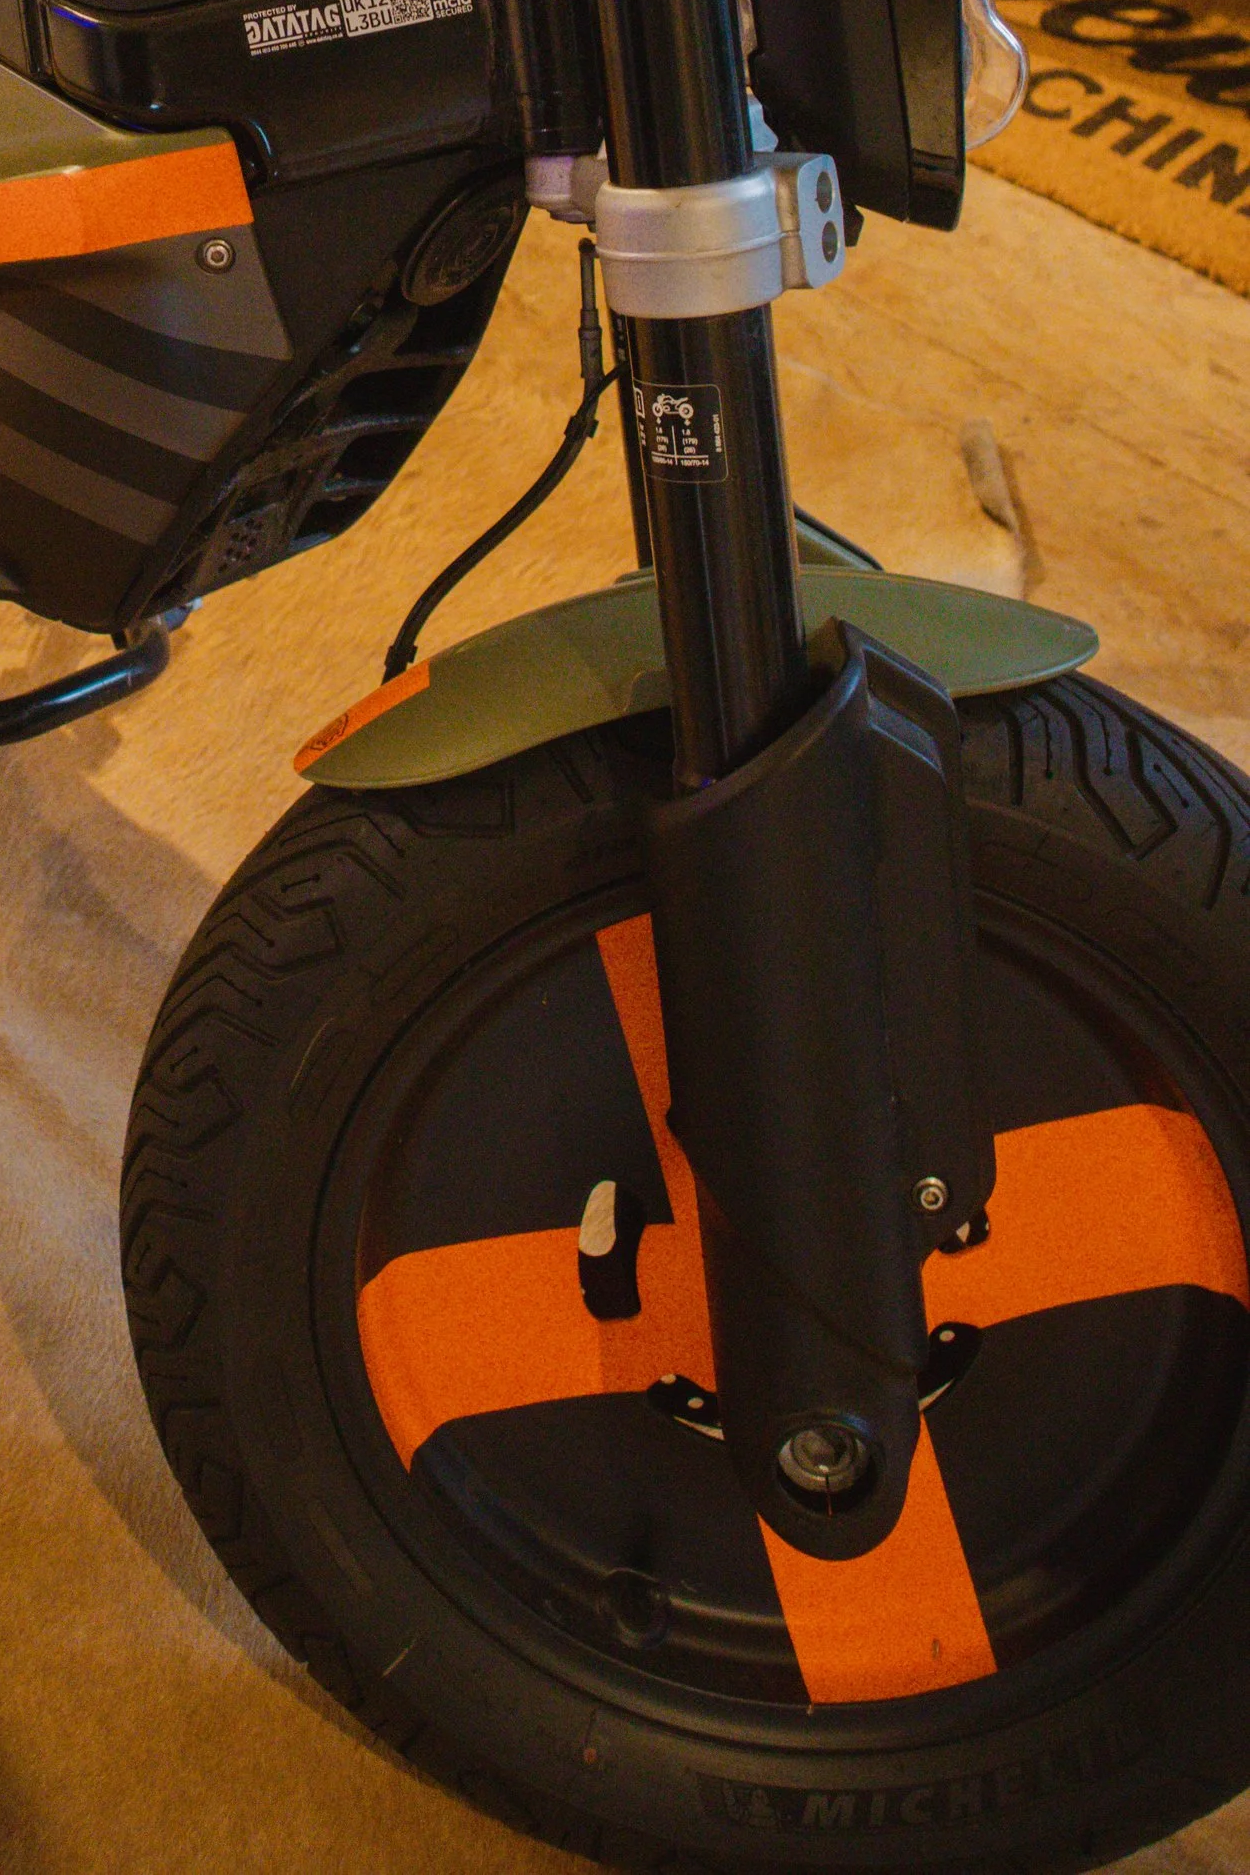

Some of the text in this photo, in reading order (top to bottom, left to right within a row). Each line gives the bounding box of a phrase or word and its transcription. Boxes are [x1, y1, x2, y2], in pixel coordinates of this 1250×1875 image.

[243, 4, 297, 21] PROTECTED BY
[245, 3, 341, 45] DATATAG
[346, 8, 393, 33] L3BU
[435, 4, 474, 19] SECURED
[1022, 69, 1250, 218] CHIN
